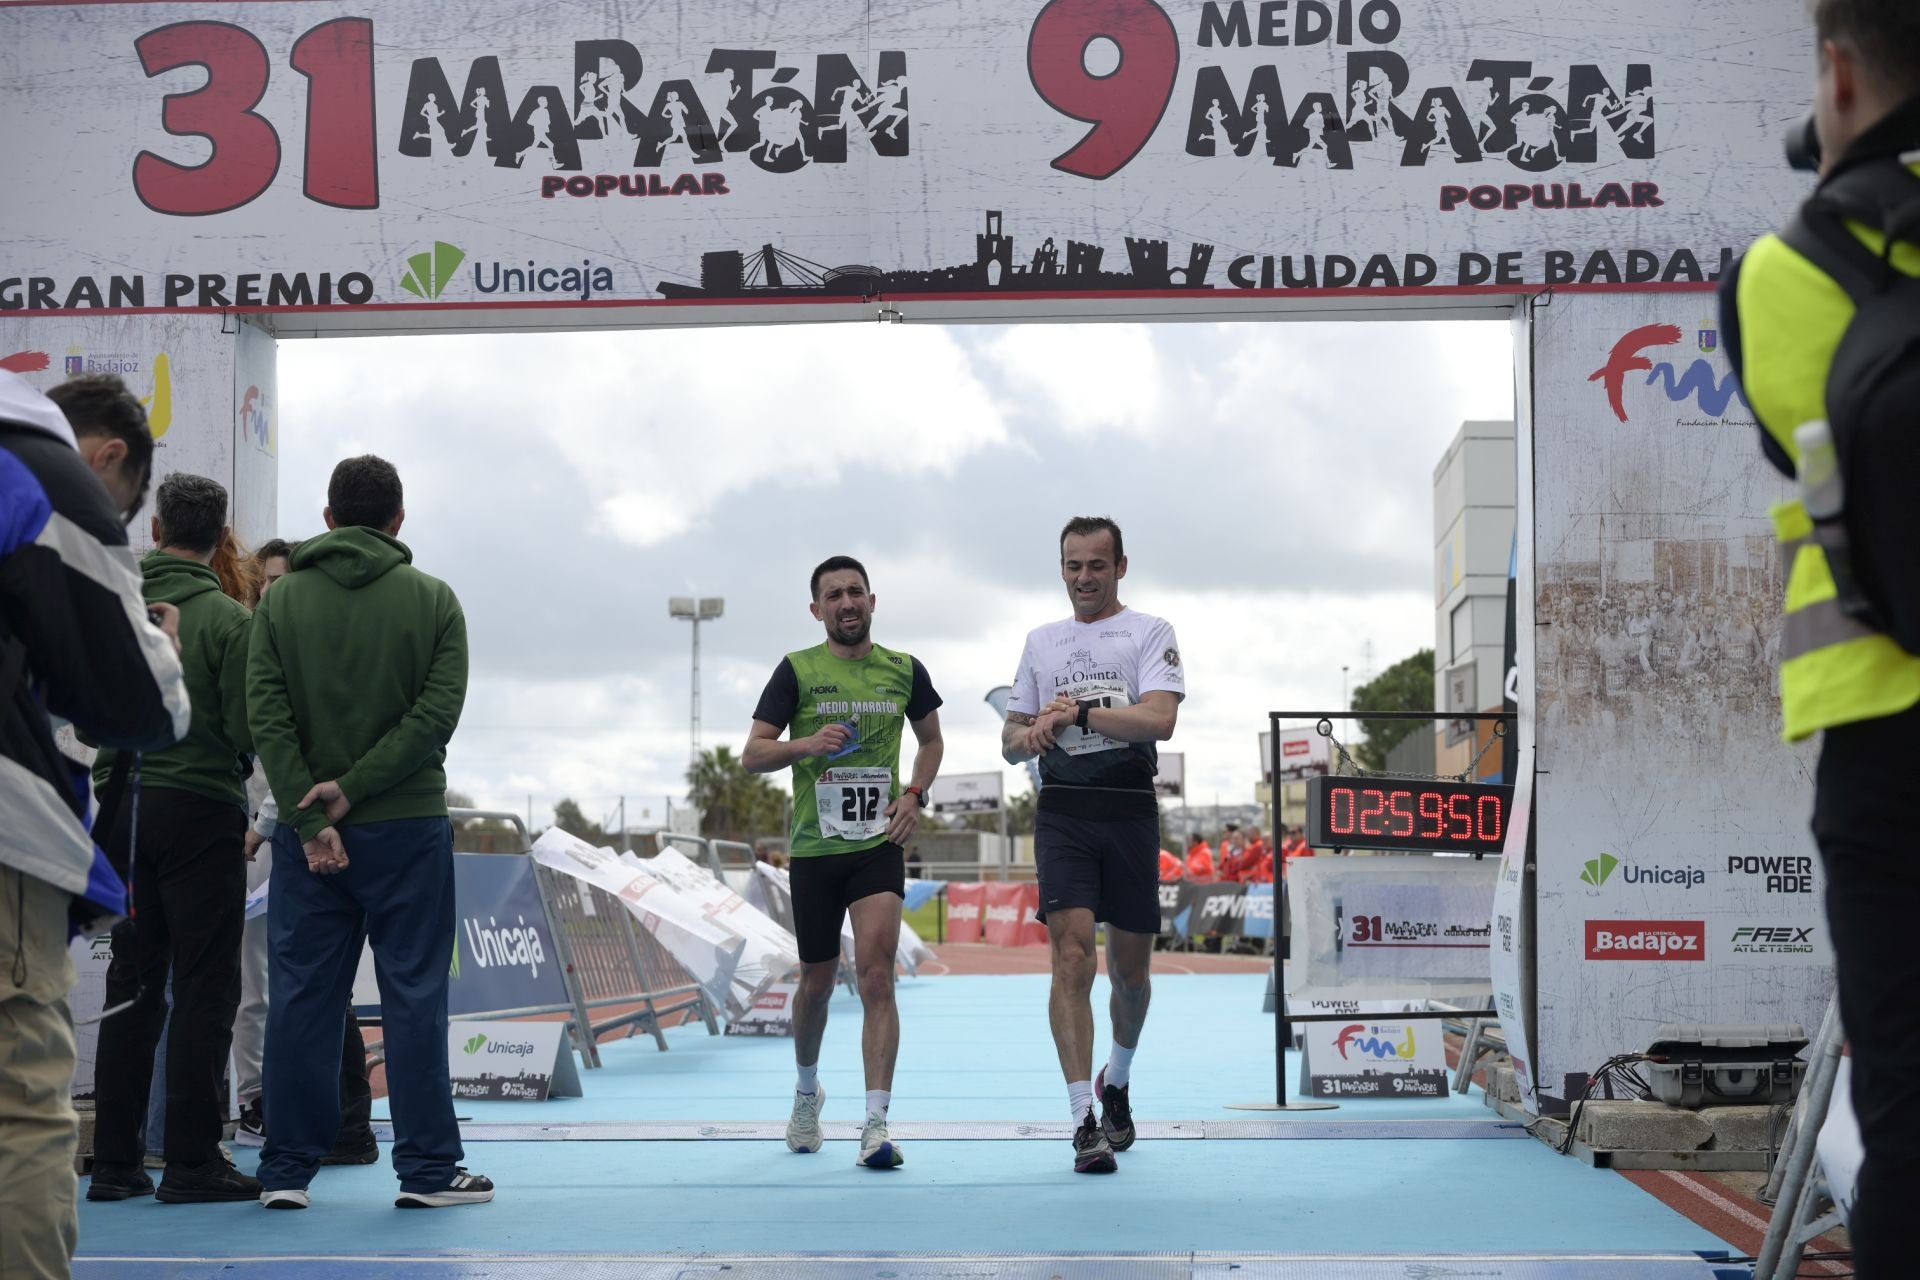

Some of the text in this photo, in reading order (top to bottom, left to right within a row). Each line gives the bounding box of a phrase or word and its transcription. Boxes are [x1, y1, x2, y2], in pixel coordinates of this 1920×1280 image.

[1197, 0, 1401, 47] MEDIO
[1027, 0, 1180, 180] 9
[132, 16, 380, 217] 31
[541, 172, 731, 198] POPULAR
[1440, 182, 1665, 211] POPULAR
[474, 259, 613, 300] Unicaja
[1227, 247, 1735, 289] CIUDAD DE BADAJ
[0, 271, 374, 310] GRAN PREMIO
[87, 359, 139, 374] Badajoz
[810, 685, 838, 695] HOKA
[1055, 675, 1069, 688] La
[816, 699, 898, 714] MEDIO MARATÓN
[842, 787, 880, 821] 212
[1331, 788, 1501, 841] 02:59:50
[1623, 864, 1706, 890] Unicaja
[1728, 855, 1812, 875] POWER
[1767, 875, 1812, 893] ADE
[1352, 915, 1383, 942] 31
[464, 914, 545, 979] Unicaja
[1596, 930, 1698, 956] Badajoz
[487, 1041, 534, 1058] Unicaja
[501, 1082, 511, 1096] 9
[1322, 1079, 1342, 1094] 31
[1393, 1078, 1403, 1092] 9
